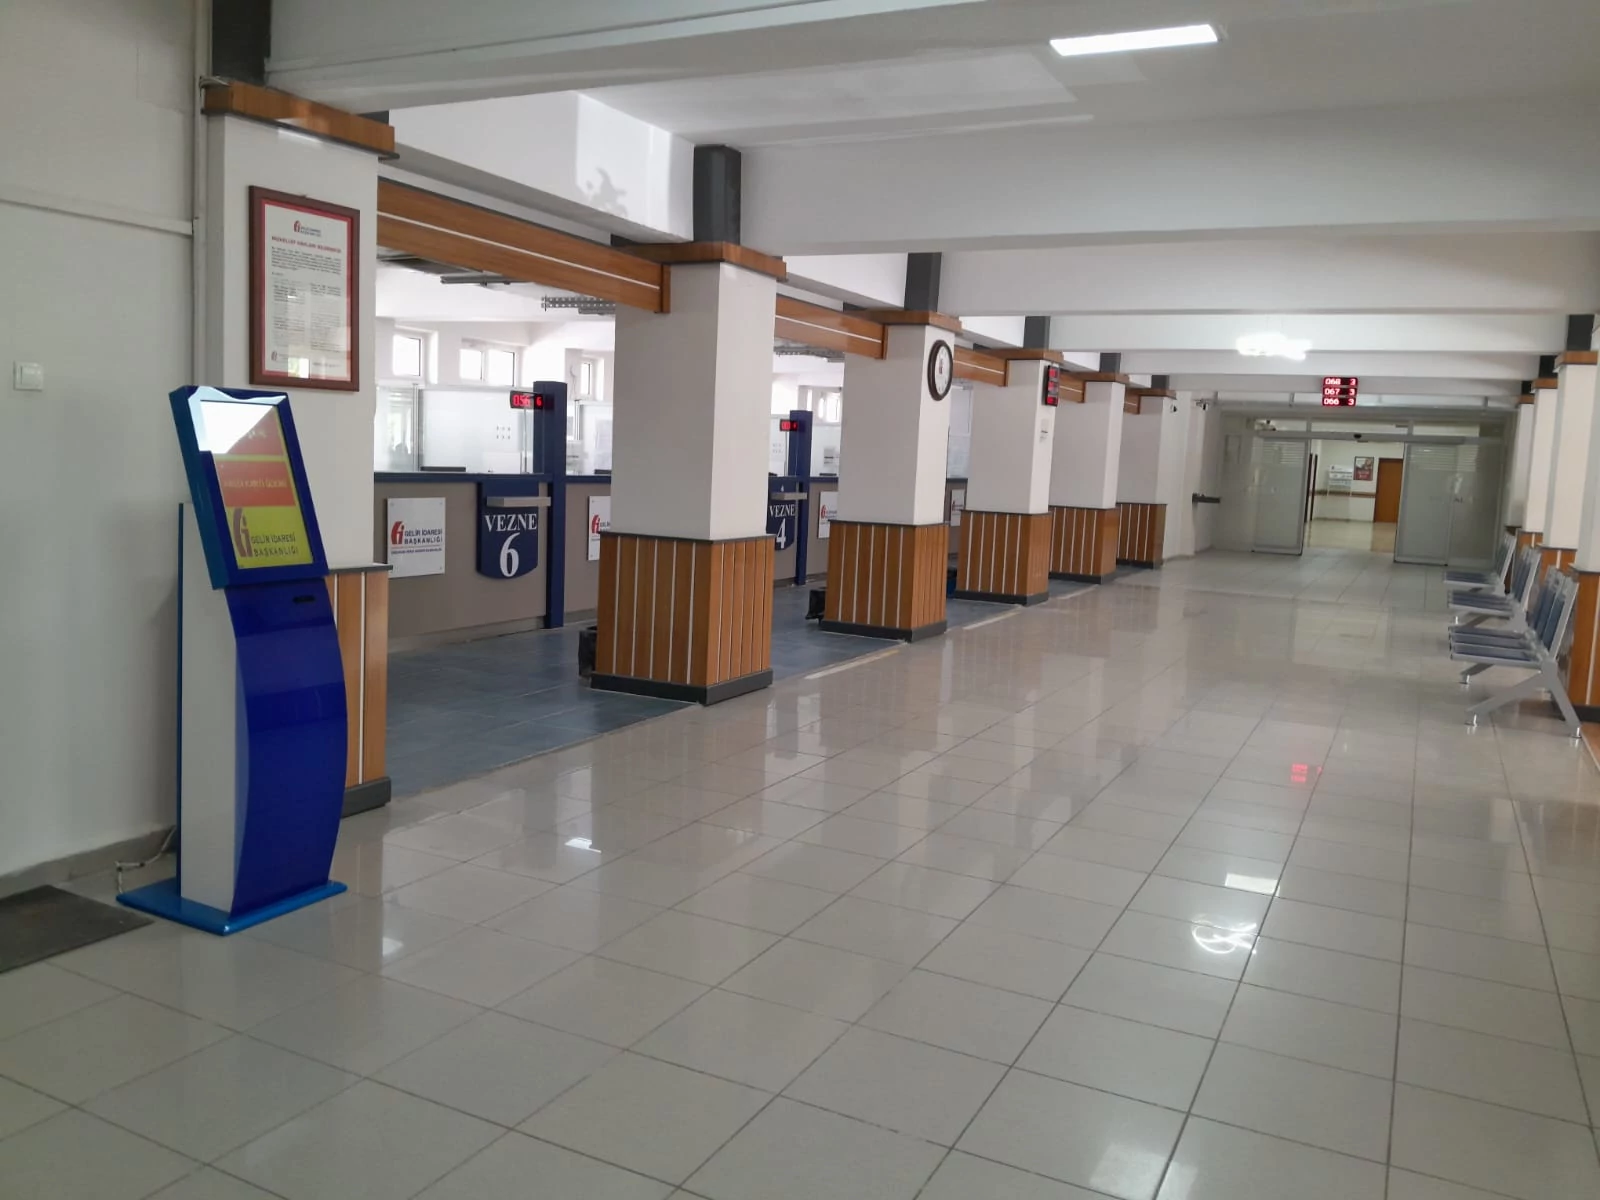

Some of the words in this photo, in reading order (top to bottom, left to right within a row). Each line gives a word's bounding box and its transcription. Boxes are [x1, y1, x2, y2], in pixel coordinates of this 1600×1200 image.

[1350, 378, 1356, 386] 3
[769, 504, 795, 517] VEZNE
[484, 513, 538, 532] VEZNE
[776, 517, 787, 549] 4
[499, 532, 521, 578] 6
